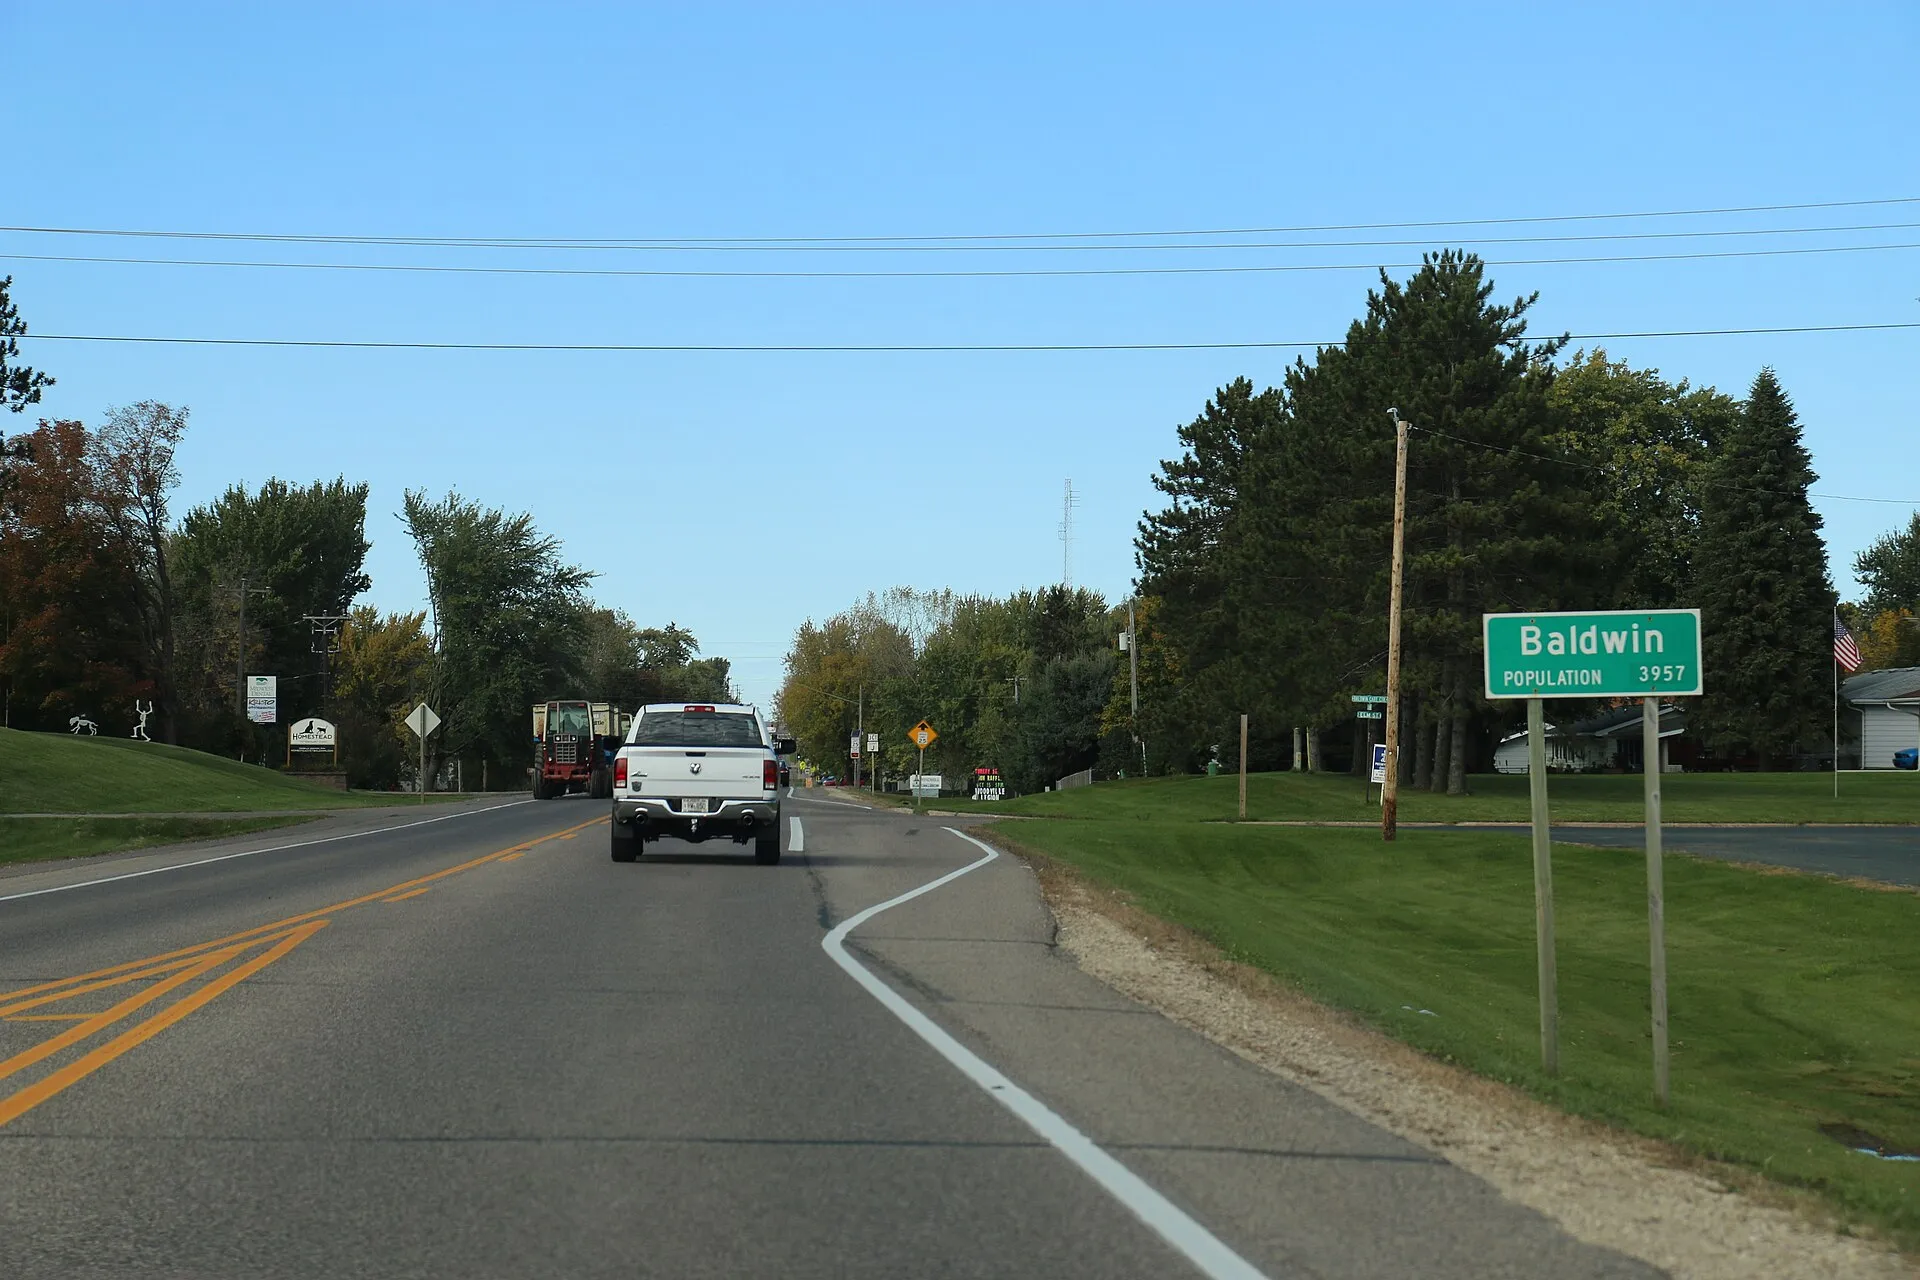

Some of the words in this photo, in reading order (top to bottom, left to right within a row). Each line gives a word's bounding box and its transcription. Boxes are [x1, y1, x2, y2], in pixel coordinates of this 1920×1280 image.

[1521, 623, 1664, 656] Baldwin
[1504, 669, 1602, 687] POPULATION
[1639, 665, 1686, 682] 3957
